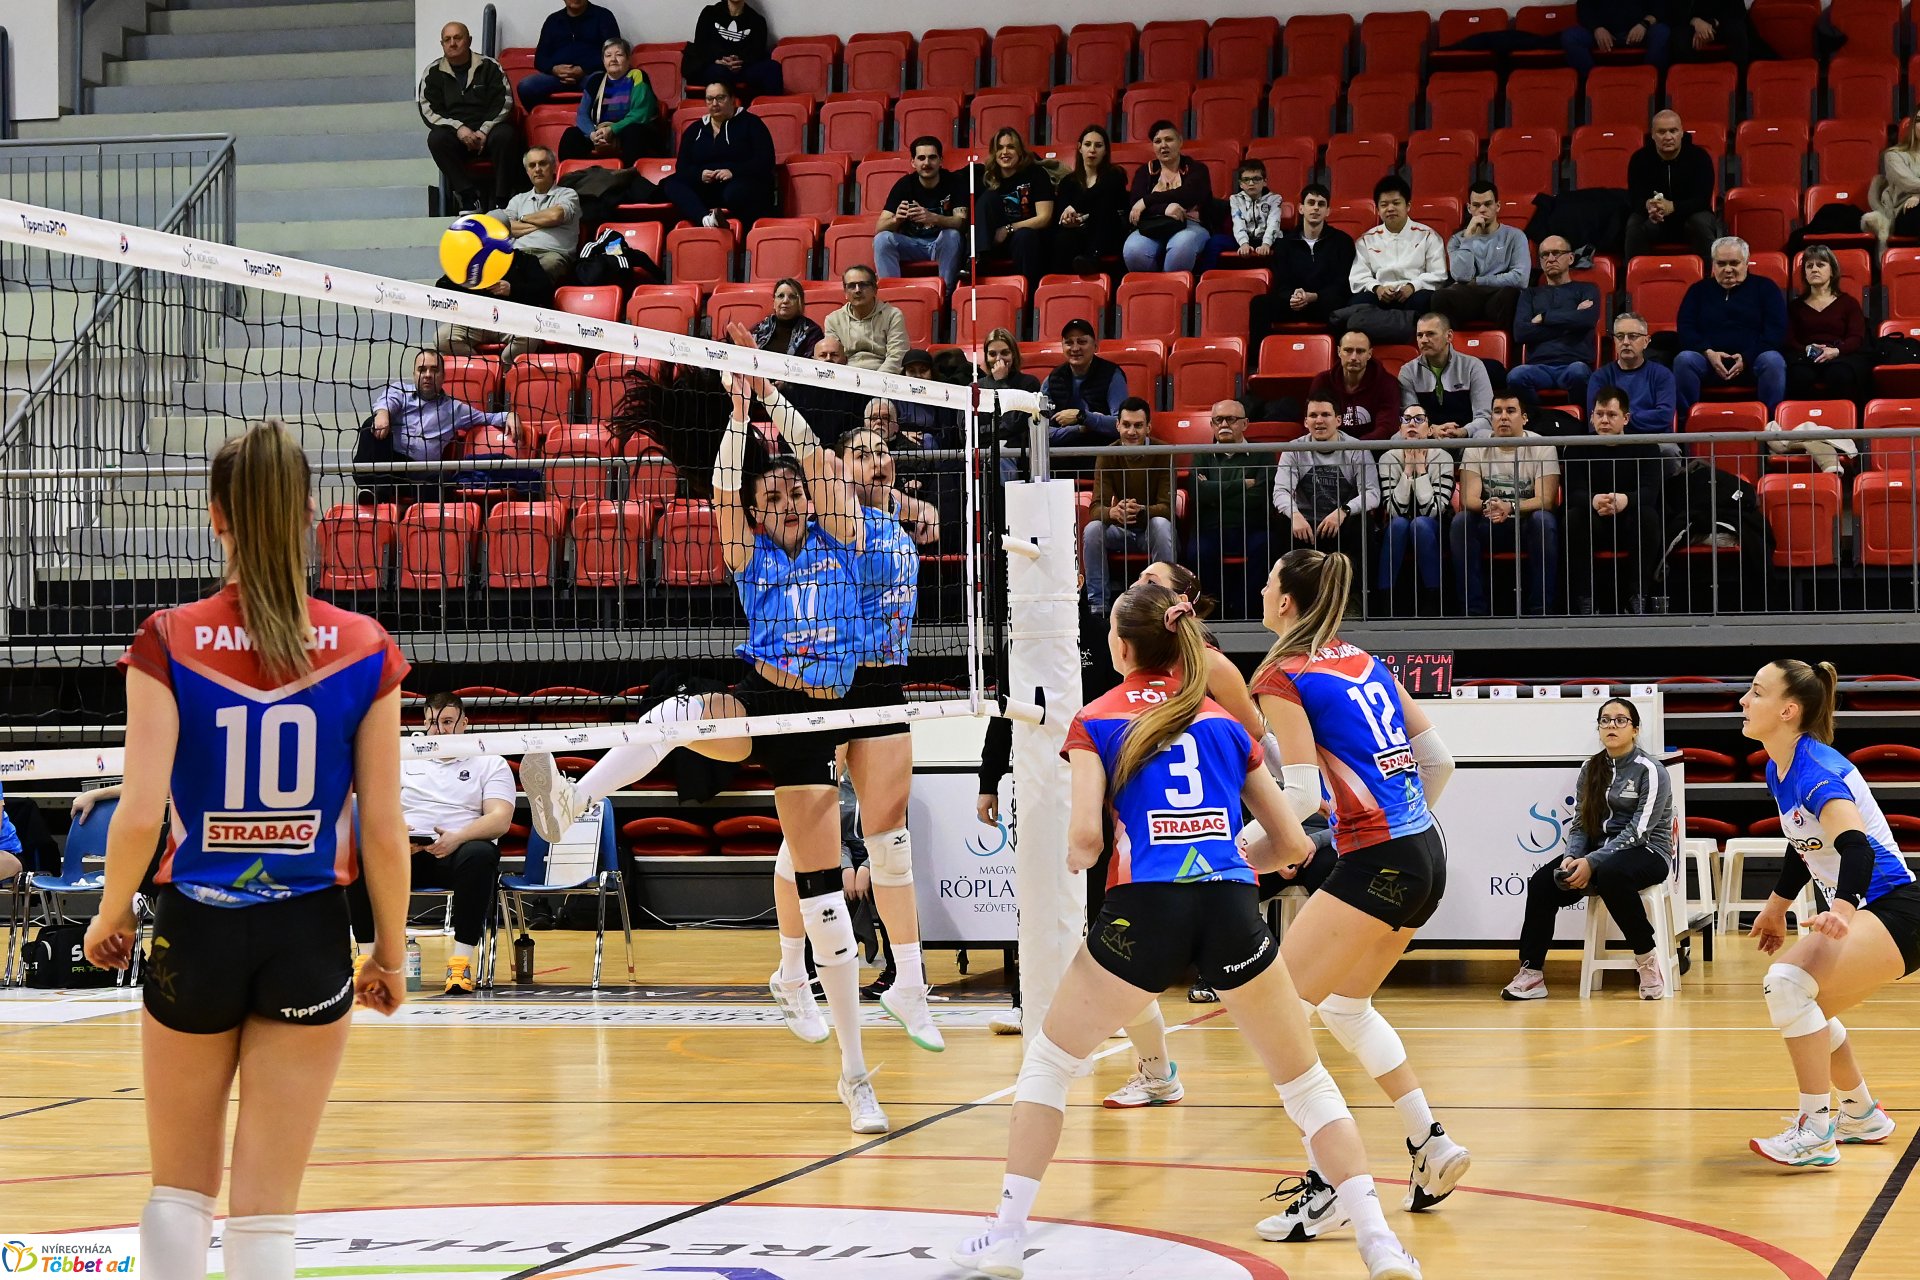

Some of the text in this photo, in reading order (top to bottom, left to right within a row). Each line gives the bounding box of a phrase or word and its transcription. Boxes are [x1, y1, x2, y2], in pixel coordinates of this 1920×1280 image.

[1407, 655, 1452, 664] FATUM
[1346, 682, 1406, 750] 12
[216, 704, 317, 810] 10
[0, 759, 35, 774] ippmixPRO
[1157, 732, 1204, 808] 3
[208, 823, 314, 841] STRABAG
[1152, 818, 1226, 834] STRABAG
[979, 866, 1017, 875] MAGYA
[940, 876, 1016, 899] RÖPLA
[973, 902, 1017, 913] SZÖVETS
[208, 1236, 1046, 1261] YÍREGYHÁZ
